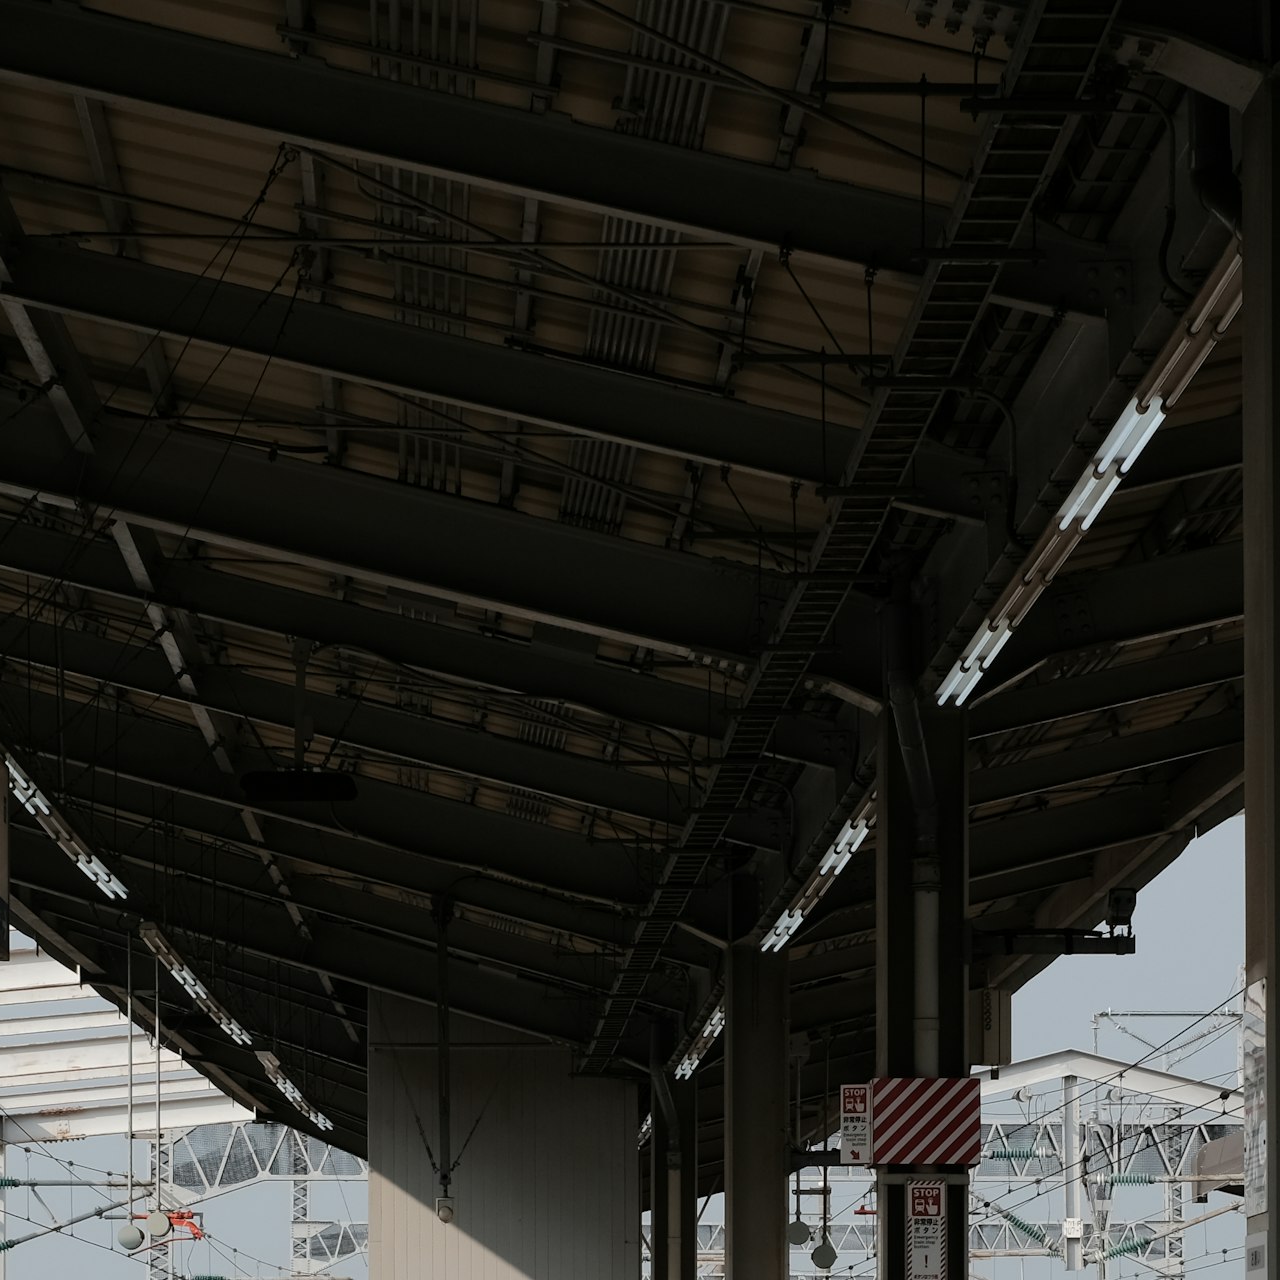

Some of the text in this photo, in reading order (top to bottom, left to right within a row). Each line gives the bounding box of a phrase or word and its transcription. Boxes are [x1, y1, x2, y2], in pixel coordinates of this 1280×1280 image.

[845, 1088, 866, 1097] STOP
[913, 1189, 939, 1197] STOP
[914, 1218, 939, 1226] 非常停止
[914, 1226, 939, 1234] ボタン
